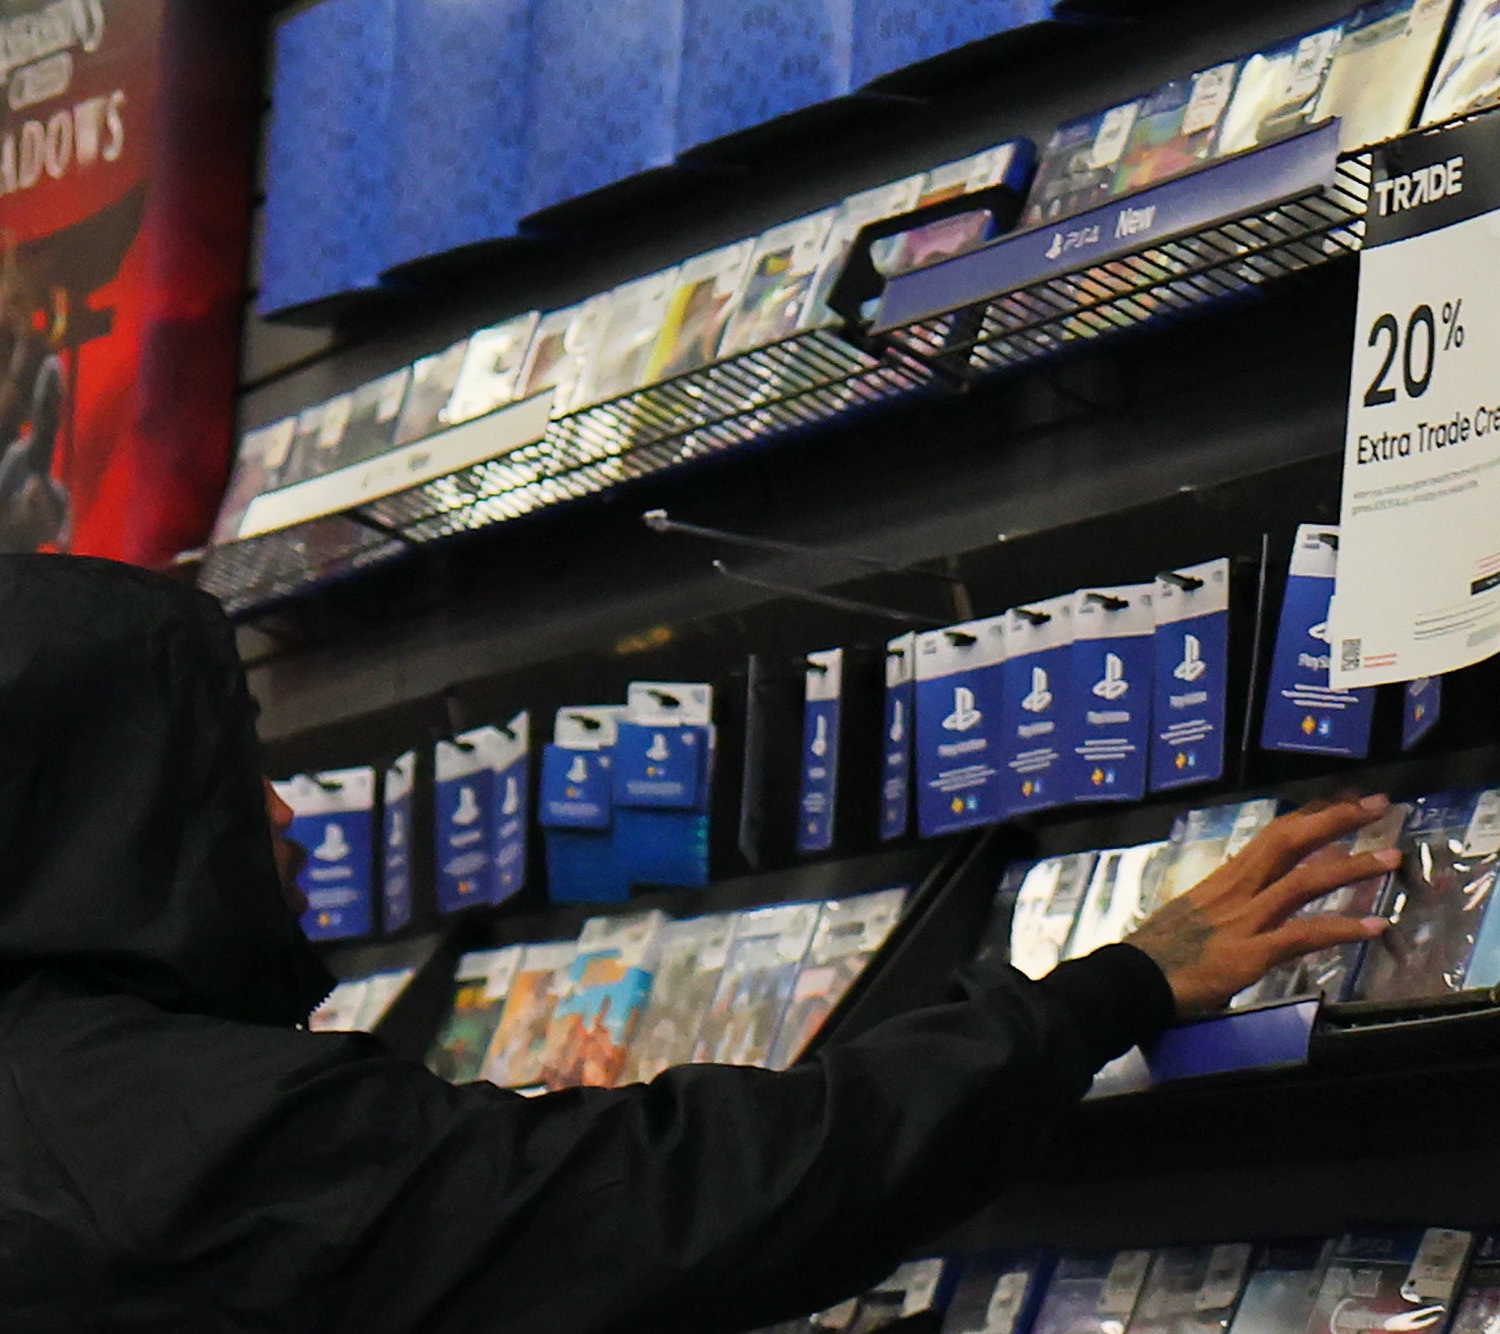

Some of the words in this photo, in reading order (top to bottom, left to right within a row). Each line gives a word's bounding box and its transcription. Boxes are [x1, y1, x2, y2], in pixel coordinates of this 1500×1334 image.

[1373, 156, 1464, 217] TRADE
[1115, 202, 1155, 240] New
[1363, 297, 1465, 409] 20%
[1356, 431, 1411, 466] Extra
[1417, 411, 1472, 453] Trade
